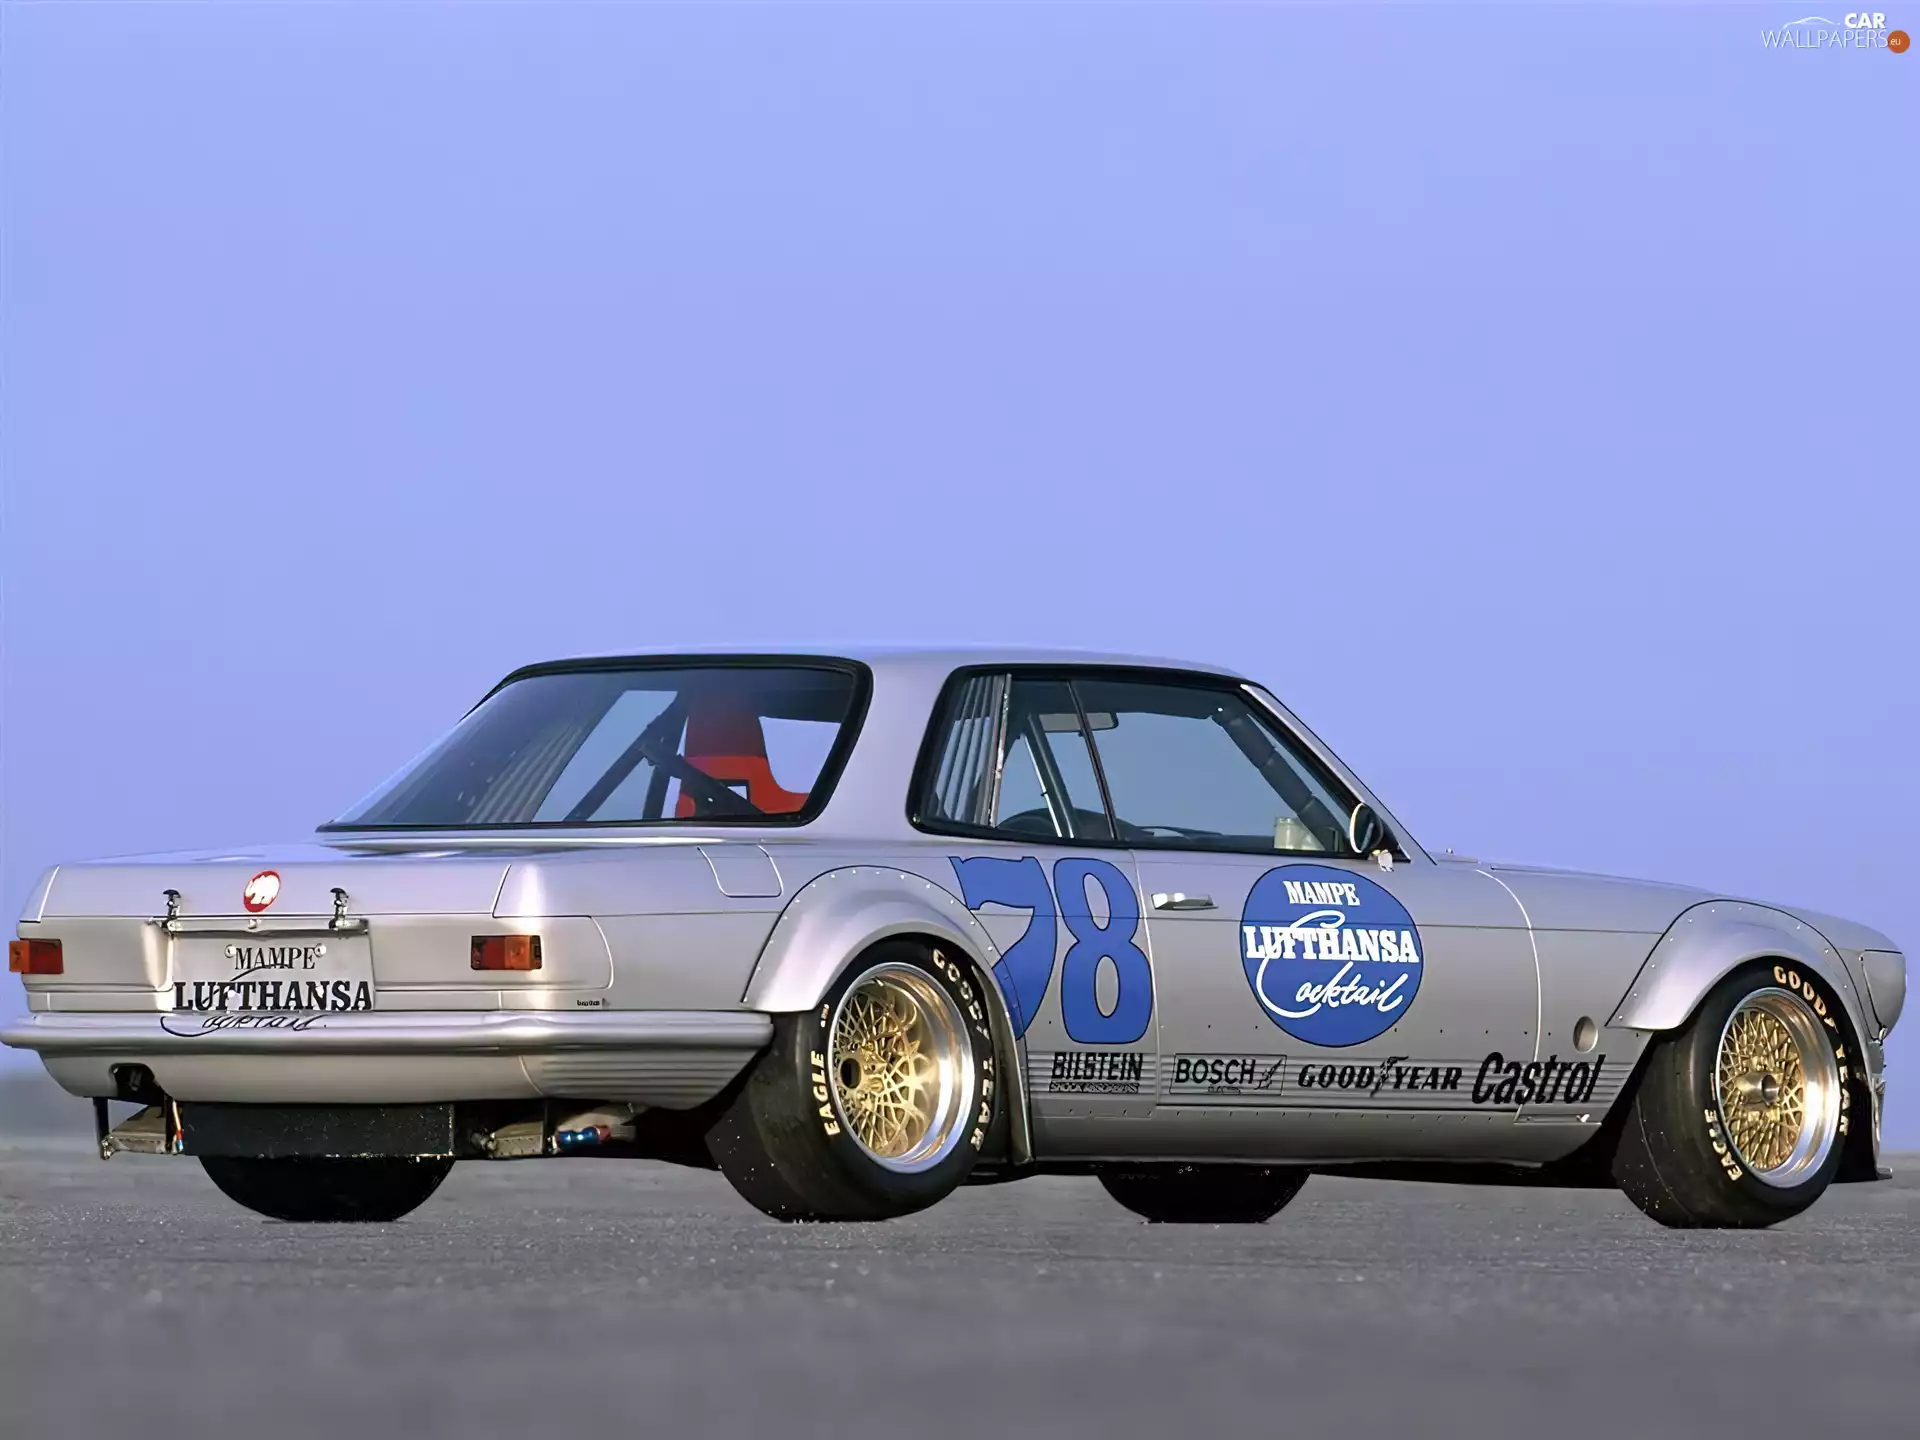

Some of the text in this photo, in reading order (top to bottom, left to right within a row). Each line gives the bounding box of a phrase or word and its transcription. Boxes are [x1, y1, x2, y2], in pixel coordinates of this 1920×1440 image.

[1283, 881, 1360, 905] MAMPE
[235, 947, 316, 970] MAMPE
[948, 856, 1153, 1044] 78
[1243, 925, 1420, 963] LUFTHANSA
[172, 980, 373, 1011] LUFTHANSA
[1051, 1052, 1144, 1081] BILSTEIN
[1174, 1058, 1257, 1085] BOSCH
[1471, 1051, 1607, 1105] Castrol
[811, 1050, 841, 1136] EAGLE
